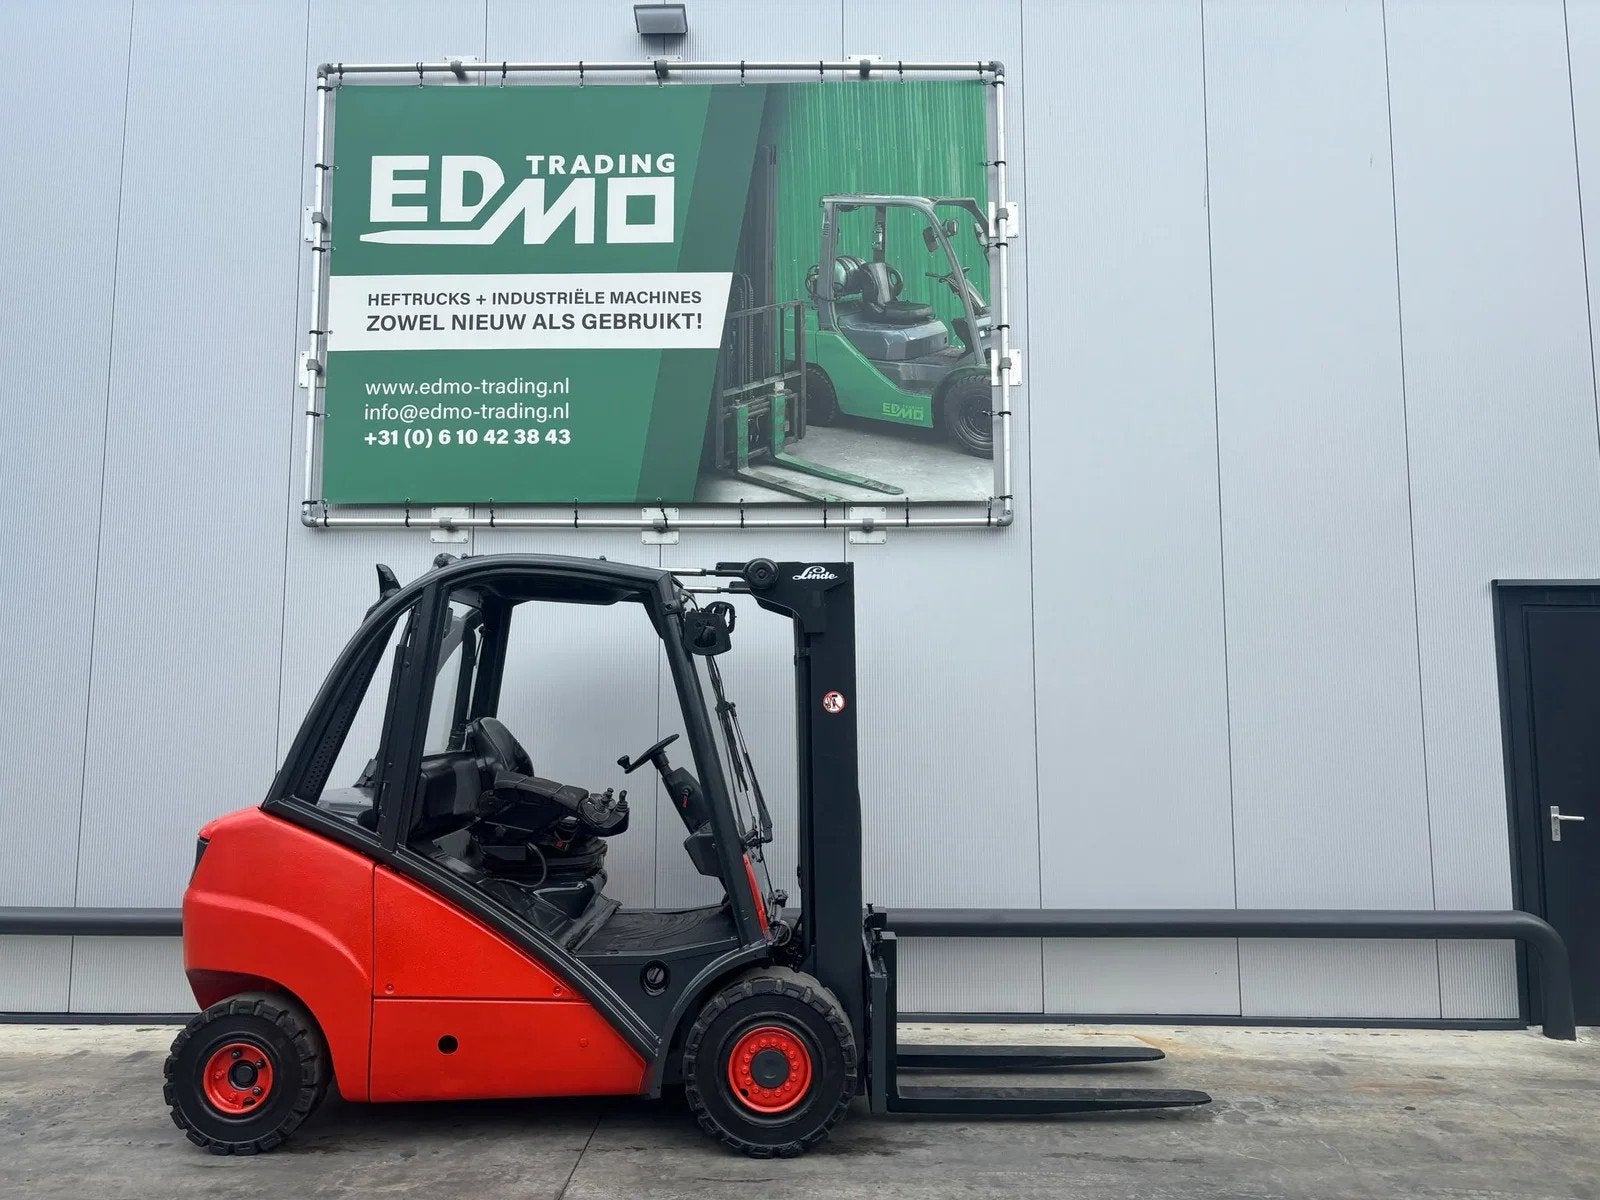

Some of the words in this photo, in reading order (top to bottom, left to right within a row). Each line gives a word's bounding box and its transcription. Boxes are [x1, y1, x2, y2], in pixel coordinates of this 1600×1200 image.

[525, 153, 675, 175] TRADING
[360, 154, 675, 245] EDMO
[367, 292, 471, 307] HEFTRUCKS
[475, 294, 487, 305] +
[492, 288, 605, 305] INDUSTRIËLE
[609, 290, 702, 305] MACHINES
[366, 314, 445, 332] ZOWEL
[451, 313, 527, 331] NIEUW
[531, 313, 576, 330] ALS
[581, 312, 703, 330] GEBRUIKT!
[365, 377, 570, 398] www.edmo-trading.nl
[364, 402, 570, 424] info@edmo-trading.nl
[882, 402, 924, 421] EDMO
[364, 429, 399, 446] +31
[404, 428, 433, 449] (0)
[438, 429, 452, 445] 6
[456, 428, 479, 445] 10
[483, 428, 509, 445] 42
[513, 428, 540, 445] 38
[544, 428, 571, 445] 43
[792, 565, 839, 580] Linde
